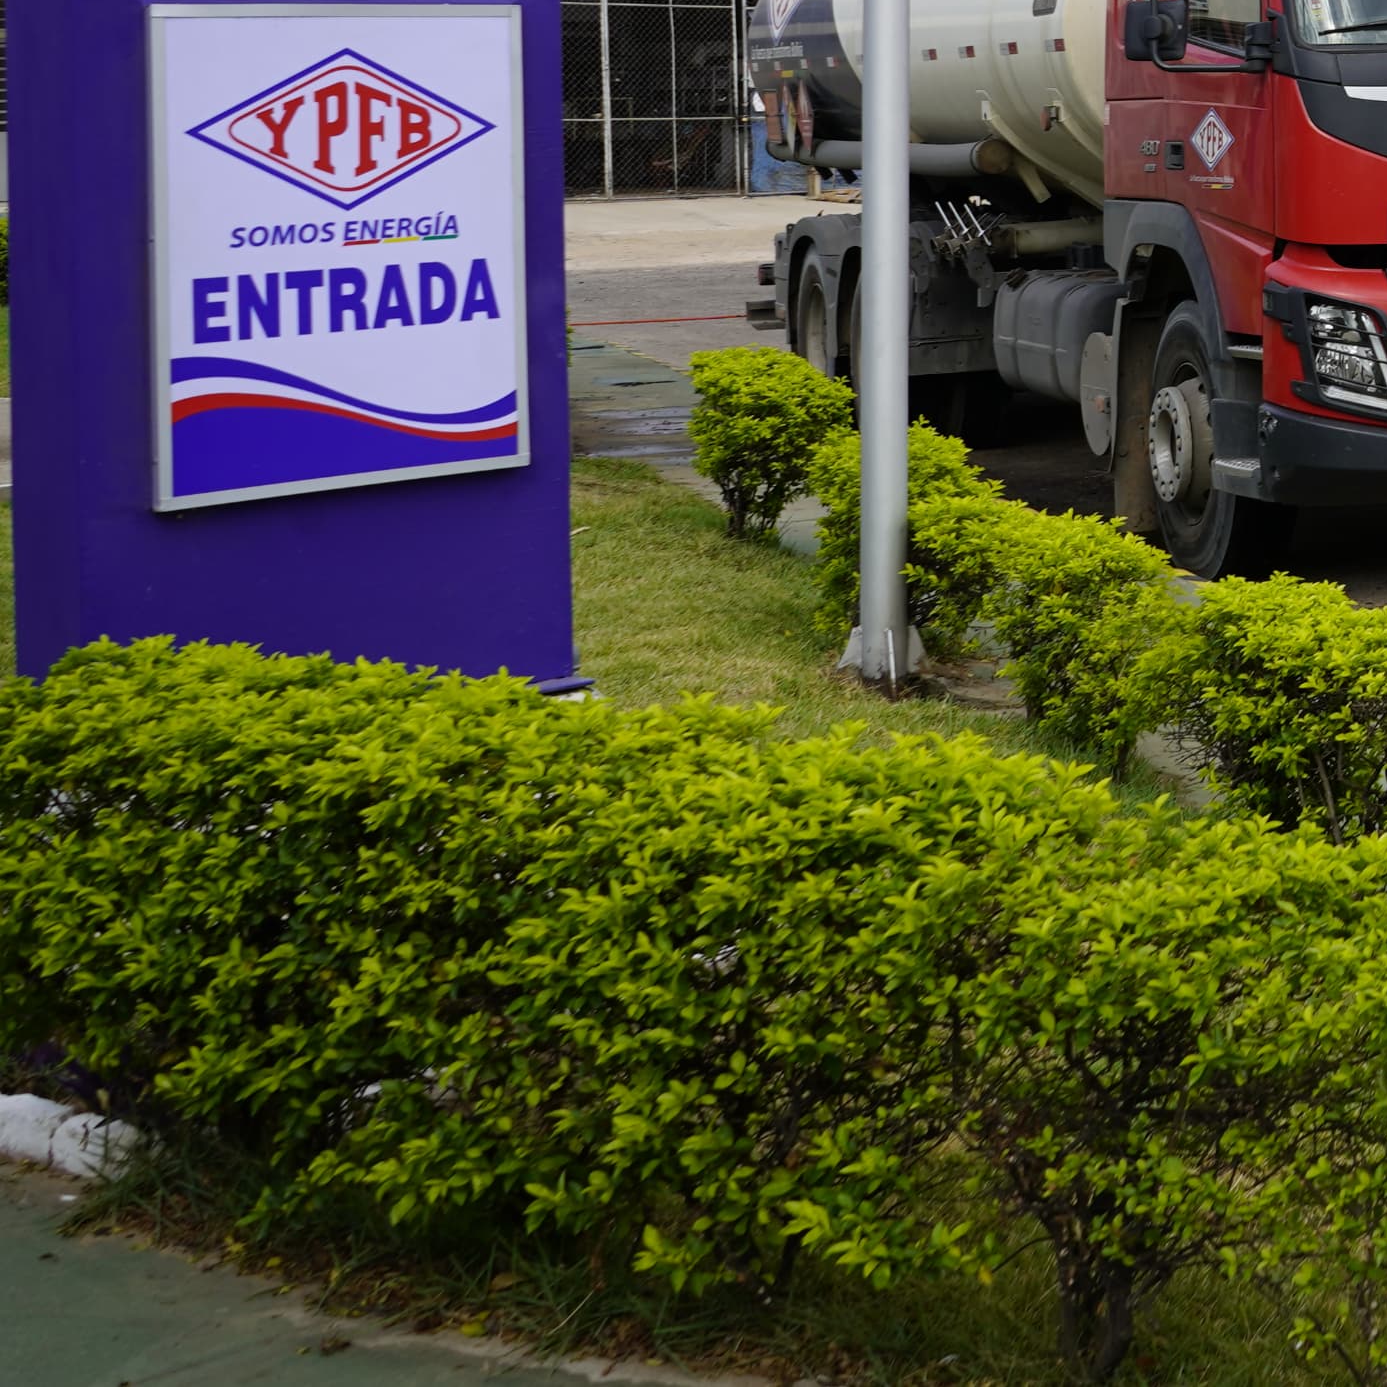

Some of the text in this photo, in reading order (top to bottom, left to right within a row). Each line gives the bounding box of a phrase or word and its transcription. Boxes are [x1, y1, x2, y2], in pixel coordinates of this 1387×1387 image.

[257, 81, 432, 176] YPFB
[1199, 120, 1224, 159] YPFB
[230, 210, 460, 249] SOMOS ENERGÍA
[192, 258, 501, 345] ENTRADA
